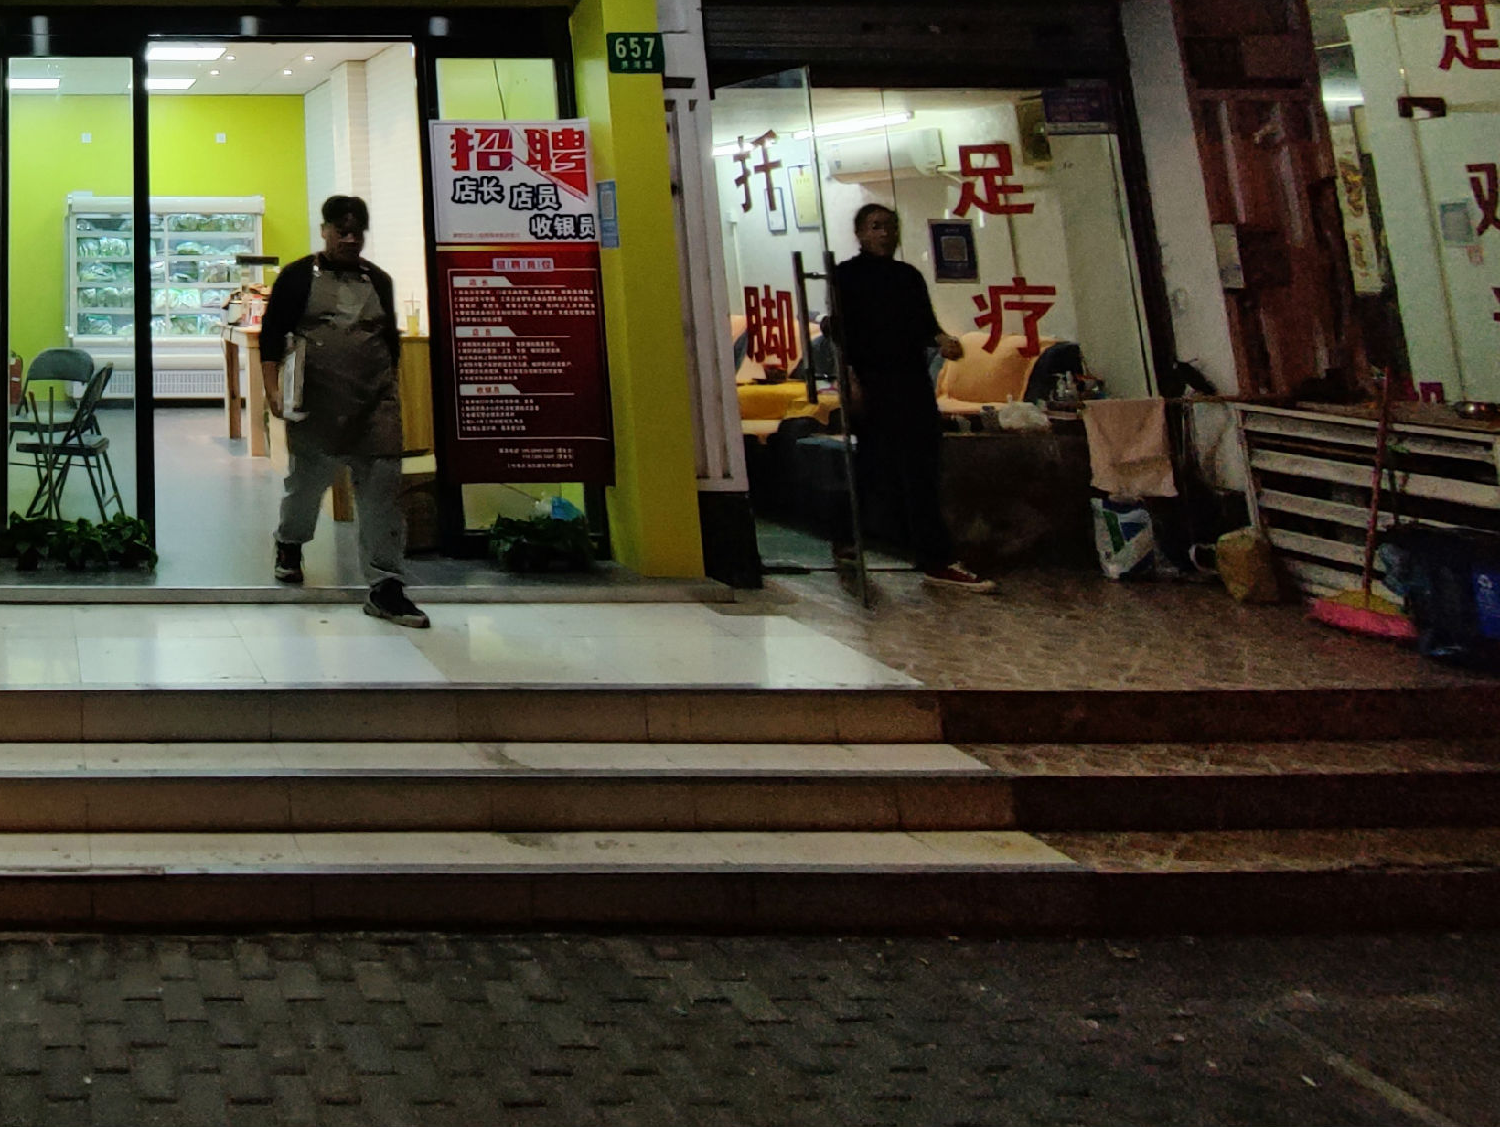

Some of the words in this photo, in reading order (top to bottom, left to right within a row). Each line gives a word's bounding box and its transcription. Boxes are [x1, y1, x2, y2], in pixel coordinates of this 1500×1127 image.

[615, 37, 655, 59] 657
[450, 128, 587, 172] 招聘
[453, 177, 503, 203] 店长
[510, 184, 561, 209] 店员
[531, 215, 595, 238] 收银员
[953, 141, 1057, 358] 足疗
